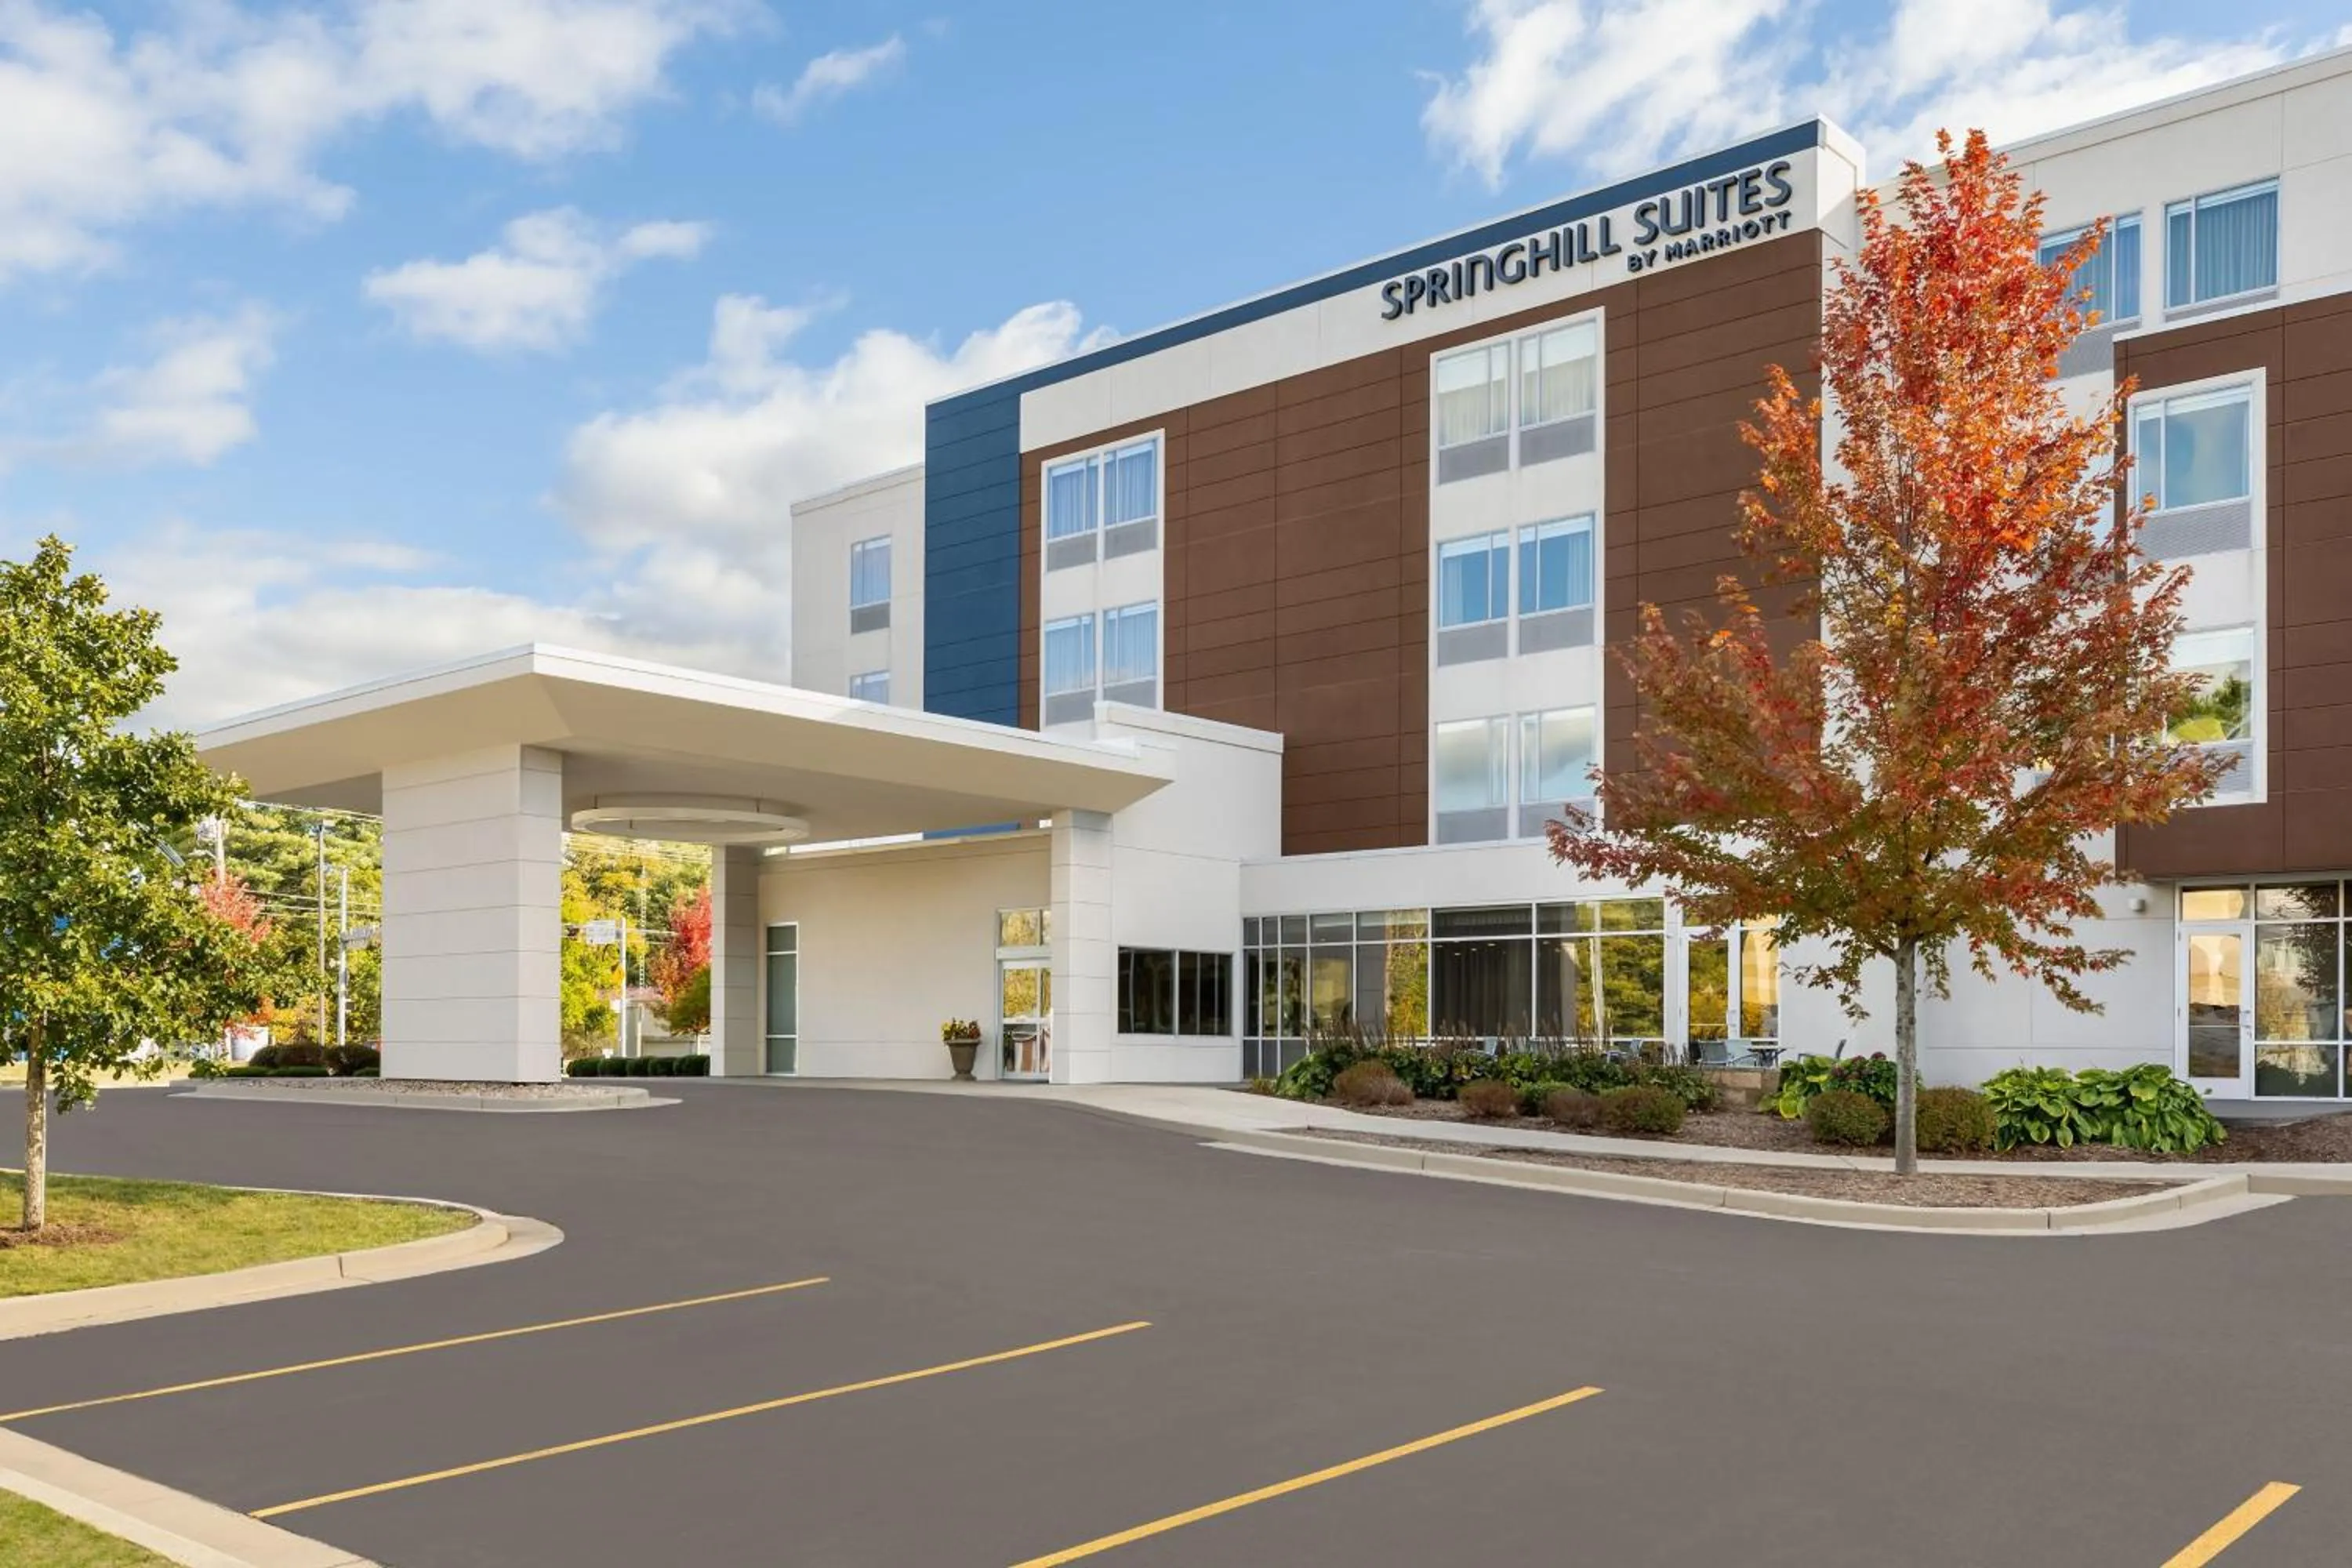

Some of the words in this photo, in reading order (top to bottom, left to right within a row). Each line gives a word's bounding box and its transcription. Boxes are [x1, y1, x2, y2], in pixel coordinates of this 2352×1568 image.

[1381, 216, 1621, 320] SPRINGHILL
[1634, 161, 1792, 245] SUITES
[1628, 249, 1657, 272] BY
[1664, 209, 1791, 262] MARRIOTT
